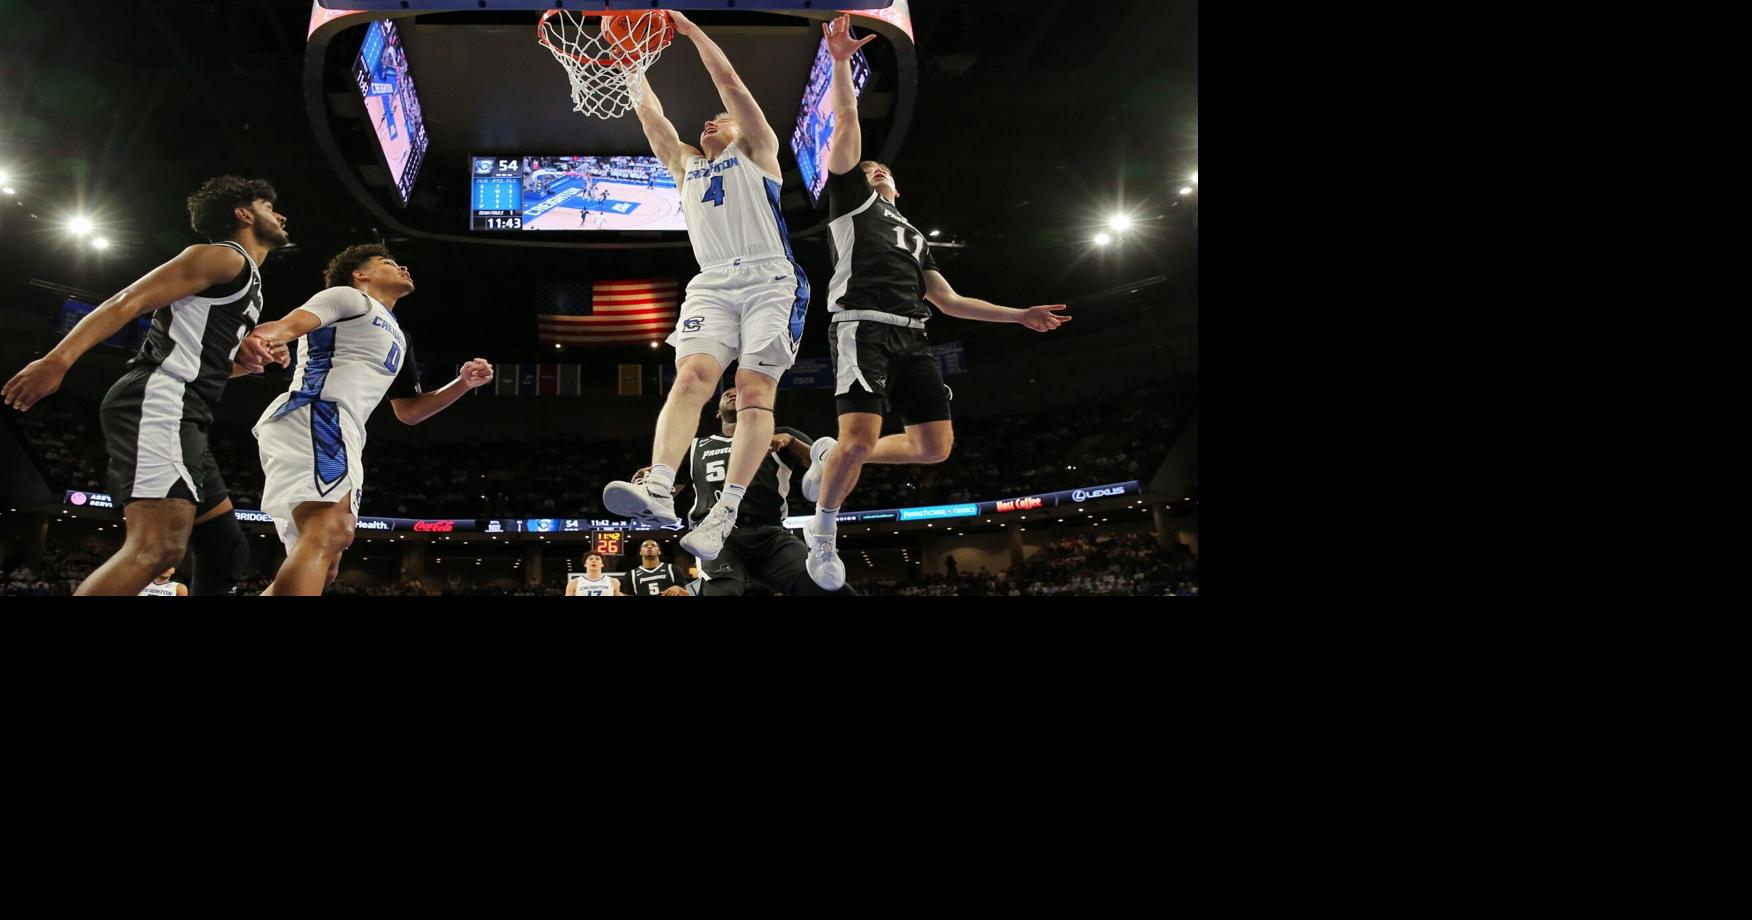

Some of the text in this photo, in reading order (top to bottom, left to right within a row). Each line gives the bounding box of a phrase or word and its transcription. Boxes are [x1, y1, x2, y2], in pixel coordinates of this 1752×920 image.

[499, 160, 518, 171] 54
[701, 175, 725, 207] 4
[488, 218, 521, 229] 11:43
[891, 226, 923, 262] 11
[384, 341, 401, 373] 0
[706, 460, 725, 482] 5
[1086, 486, 1125, 498] LEXUS
[1015, 497, 1043, 510] Coffee
[565, 520, 579, 528] 54
[598, 541, 618, 552] 26
[648, 583, 659, 595] 5
